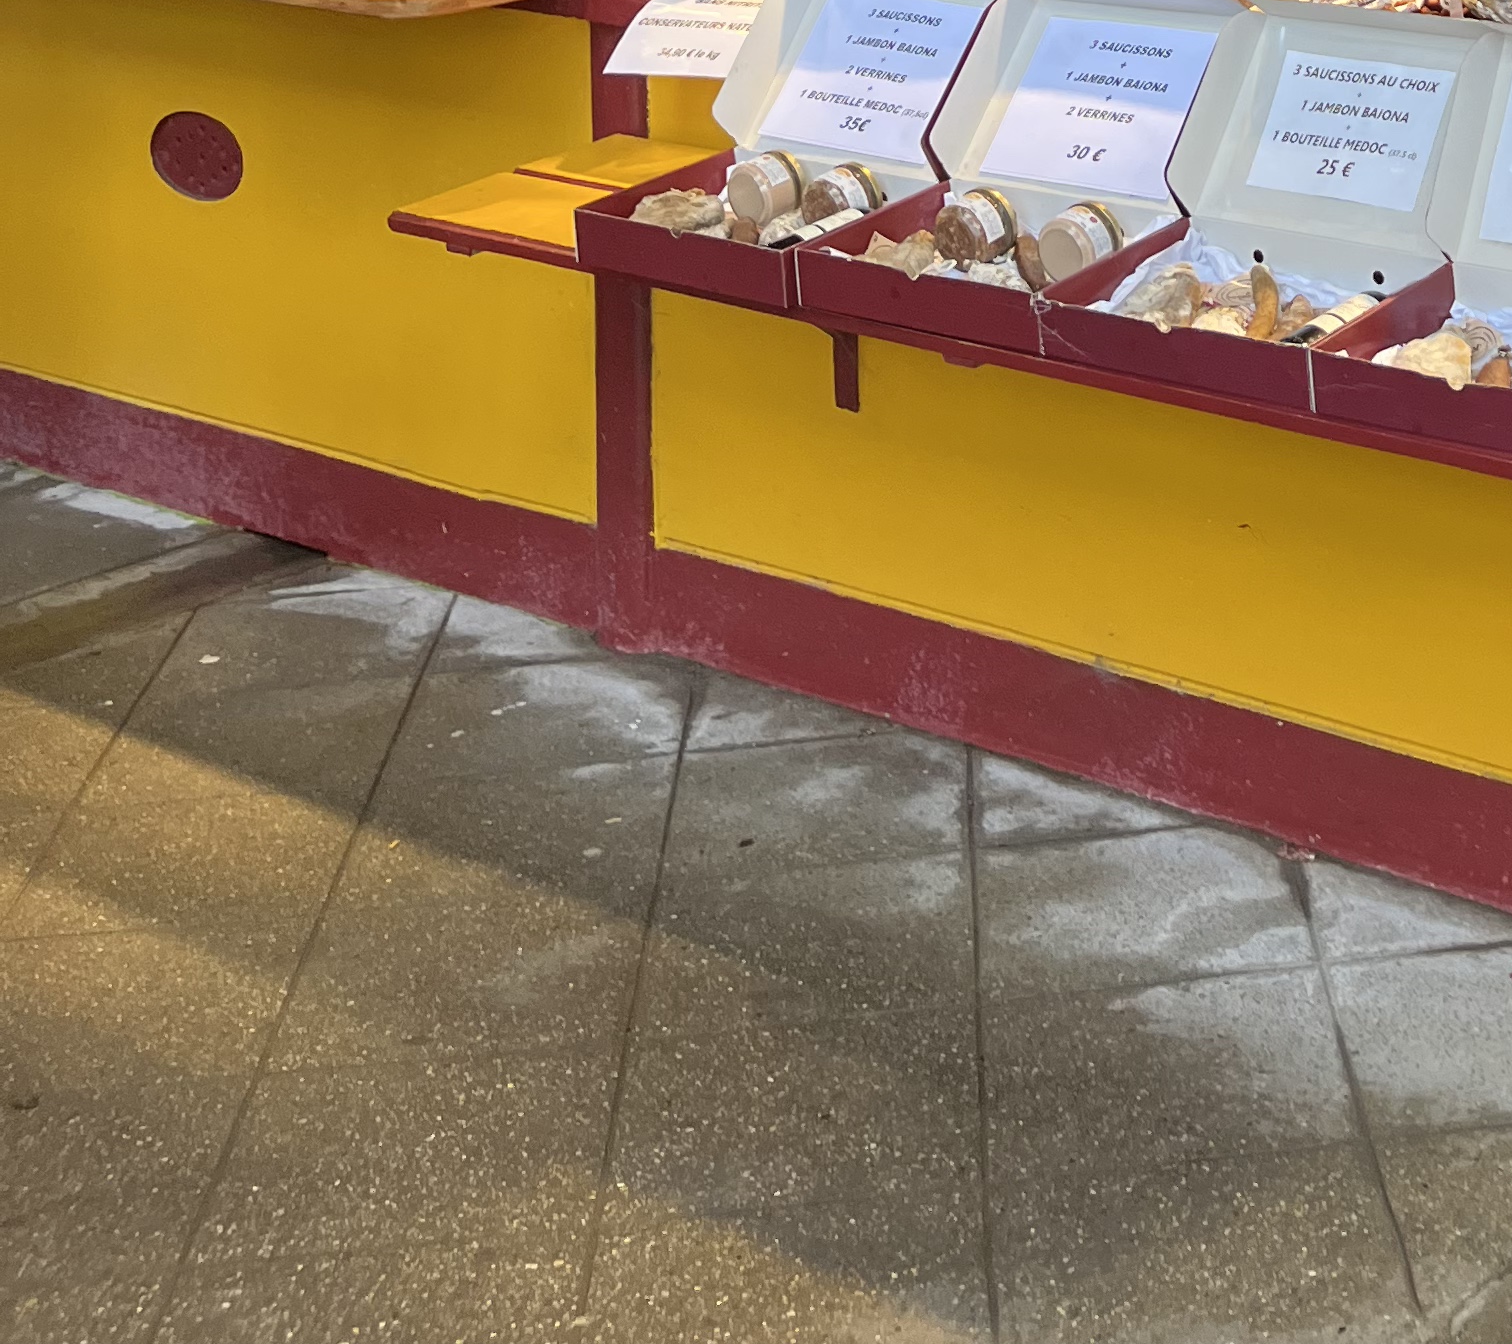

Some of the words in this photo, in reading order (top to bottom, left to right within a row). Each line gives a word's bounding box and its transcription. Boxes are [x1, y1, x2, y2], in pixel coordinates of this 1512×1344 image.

[727, 0, 763, 8] NITRIT
[638, 17, 726, 30] CONSERVATEURS
[727, 22, 752, 32] NATU
[867, 9, 877, 18] 3
[876, 9, 943, 27] SAUCISSONS
[845, 34, 853, 44] 1
[852, 35, 897, 50] JAMBON
[896, 42, 939, 58] BAIONA
[1088, 39, 1100, 50] 3
[1098, 41, 1174, 59] SAUCISSONS
[845, 64, 855, 75] 2
[855, 66, 908, 84] VERRINES
[1065, 70, 1074, 80] 1
[1073, 72, 1124, 87] JAMBON
[1122, 78, 1169, 94] BAIONA
[1292, 64, 1303, 76] 3
[1303, 65, 1378, 86] SAUCISSONS
[1377, 75, 1398, 87] AU
[1399, 78, 1441, 93] CHOIX
[800, 89, 808, 98] 1
[807, 90, 864, 108] BOUTEILLE
[863, 98, 903, 114] MEDOC
[1065, 106, 1077, 116] 2
[1076, 107, 1136, 124] VERRINES
[1300, 100, 1308, 111] 1
[1308, 101, 1361, 117] JAMBON
[1361, 106, 1410, 124] BAIONA
[1272, 130, 1280, 141] 1
[1281, 131, 1343, 149] BOUTEILLE
[1342, 139, 1389, 155] MEDOC
[1066, 144, 1091, 160] 30
[1092, 148, 1108, 162] €
[1316, 159, 1340, 175] 25
[1342, 161, 1355, 178] €
